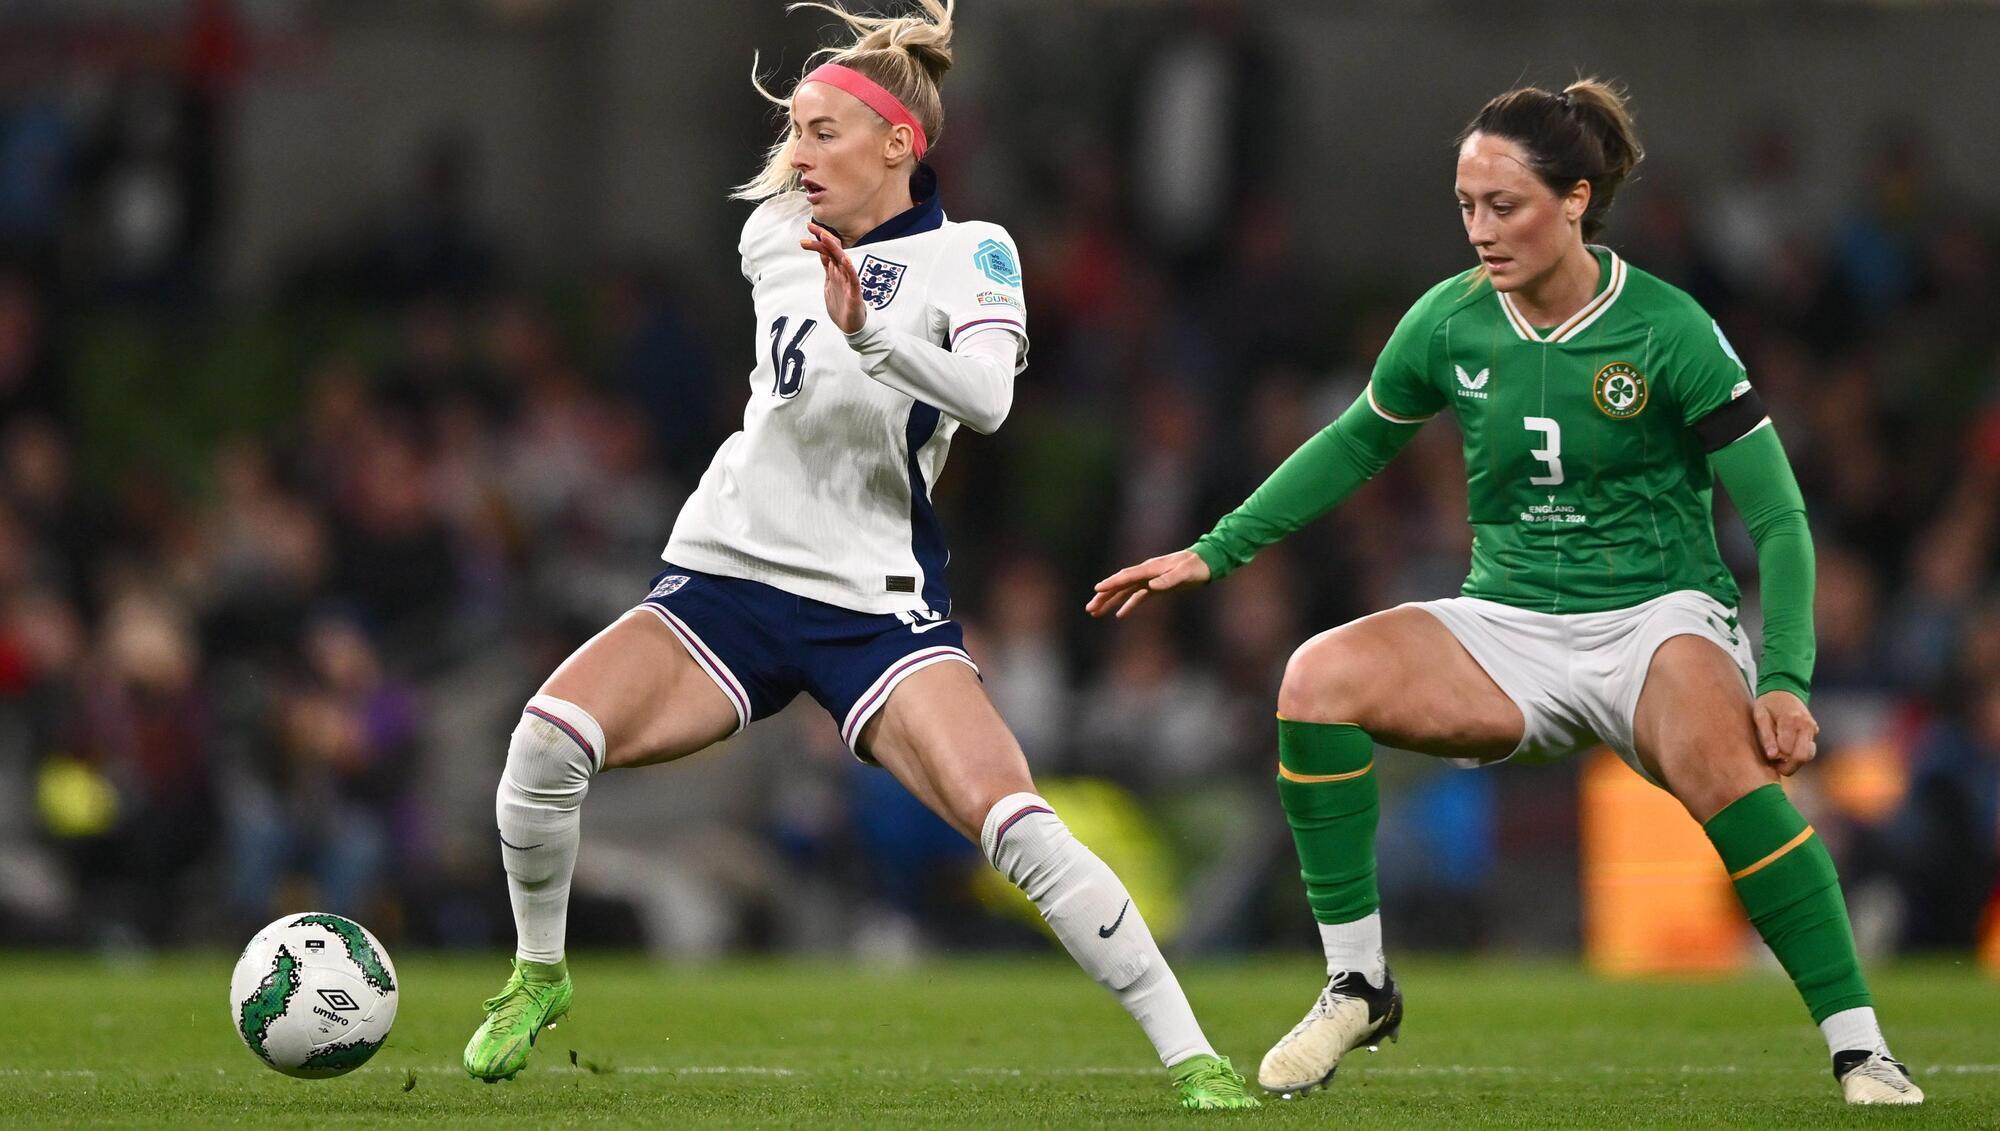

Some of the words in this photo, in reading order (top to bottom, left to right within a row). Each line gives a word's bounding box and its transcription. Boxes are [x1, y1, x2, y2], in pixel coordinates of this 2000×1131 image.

[770, 315, 818, 400] 16
[1599, 366, 1643, 385] IRELAND
[1523, 416, 1565, 486] 3
[1528, 505, 1576, 513] ENGLAND
[1535, 514, 1564, 523] APRIL
[313, 1006, 349, 1026] umbro
